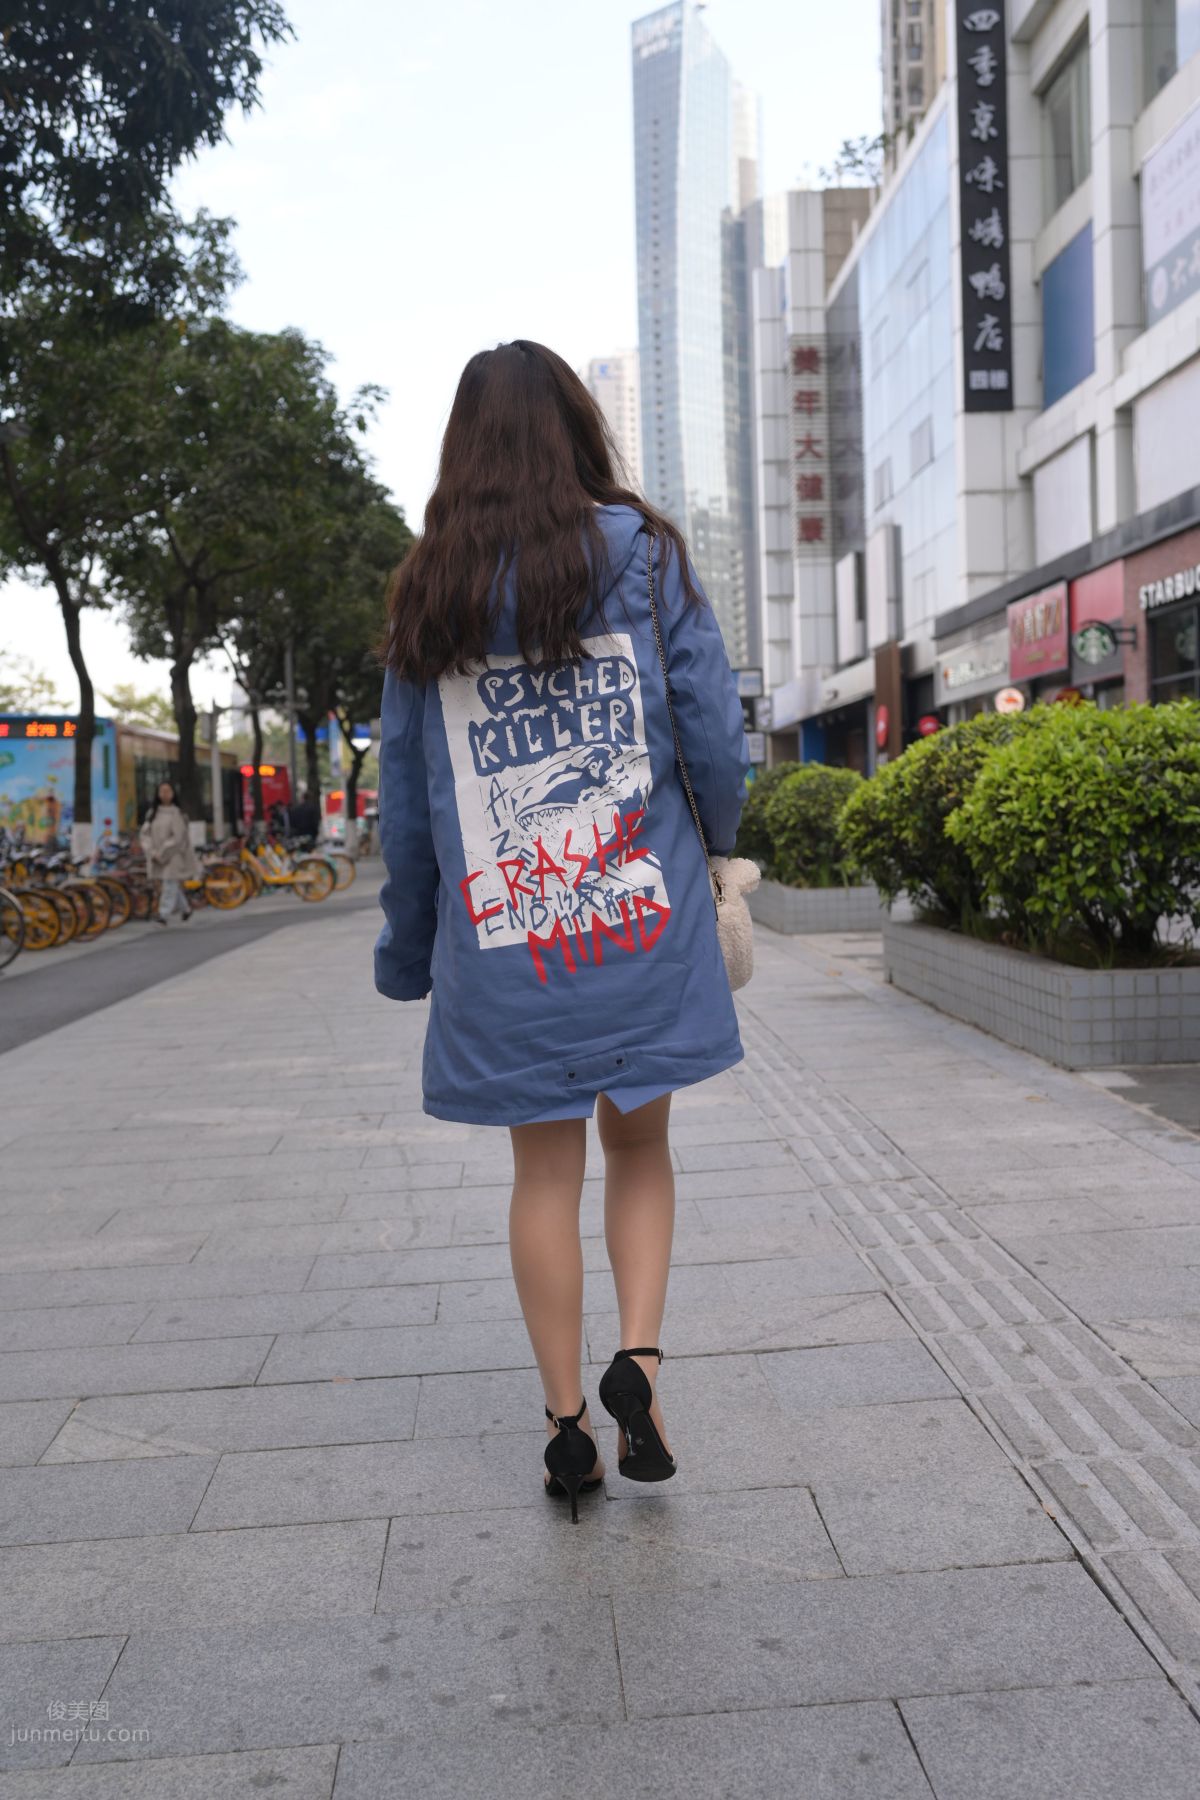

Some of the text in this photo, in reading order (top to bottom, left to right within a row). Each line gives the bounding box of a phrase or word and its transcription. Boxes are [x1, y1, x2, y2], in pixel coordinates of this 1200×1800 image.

[484, 660, 635, 707] PSYCHED
[474, 698, 628, 769] KILLER
[526, 895, 672, 985] MIND
